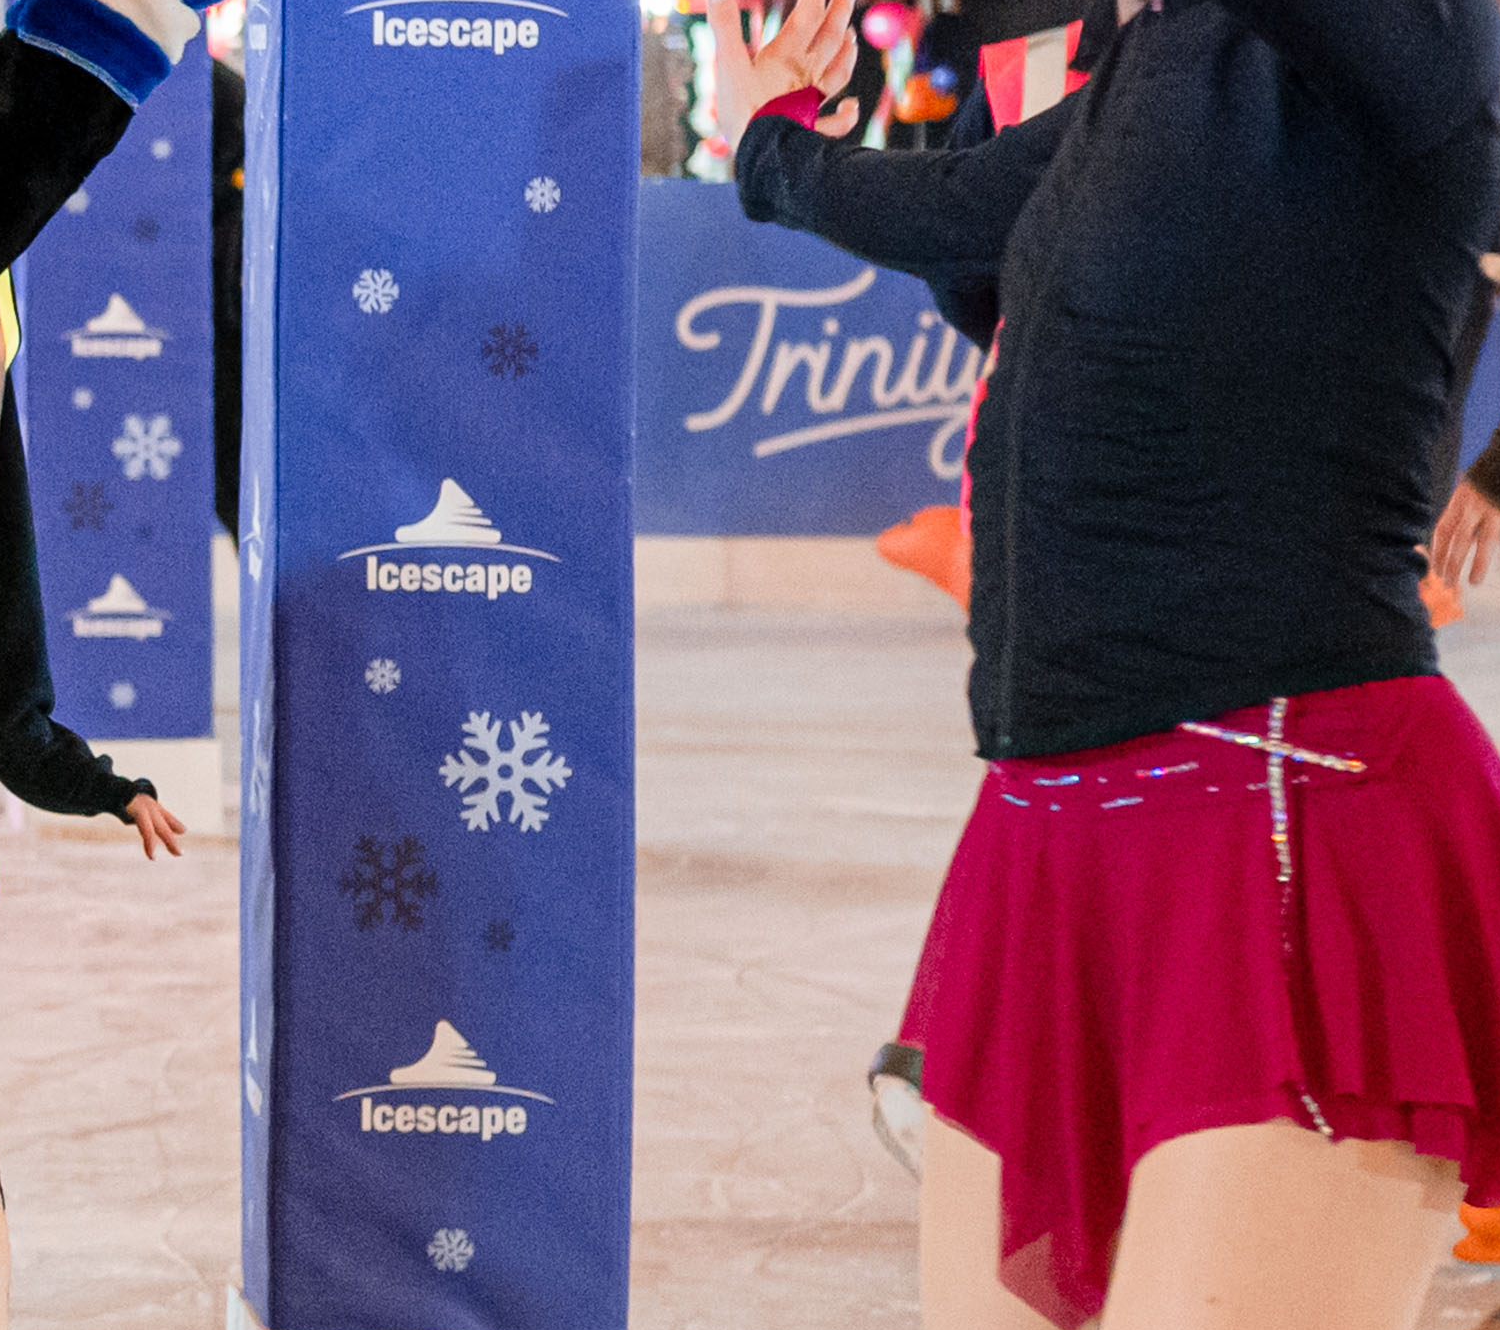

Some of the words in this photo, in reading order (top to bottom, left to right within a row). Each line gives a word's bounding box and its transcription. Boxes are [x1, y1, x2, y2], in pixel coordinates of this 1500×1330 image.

[373, 9, 540, 55] Icescape
[366, 554, 533, 601] Icescape
[360, 1096, 527, 1142] Icescape
